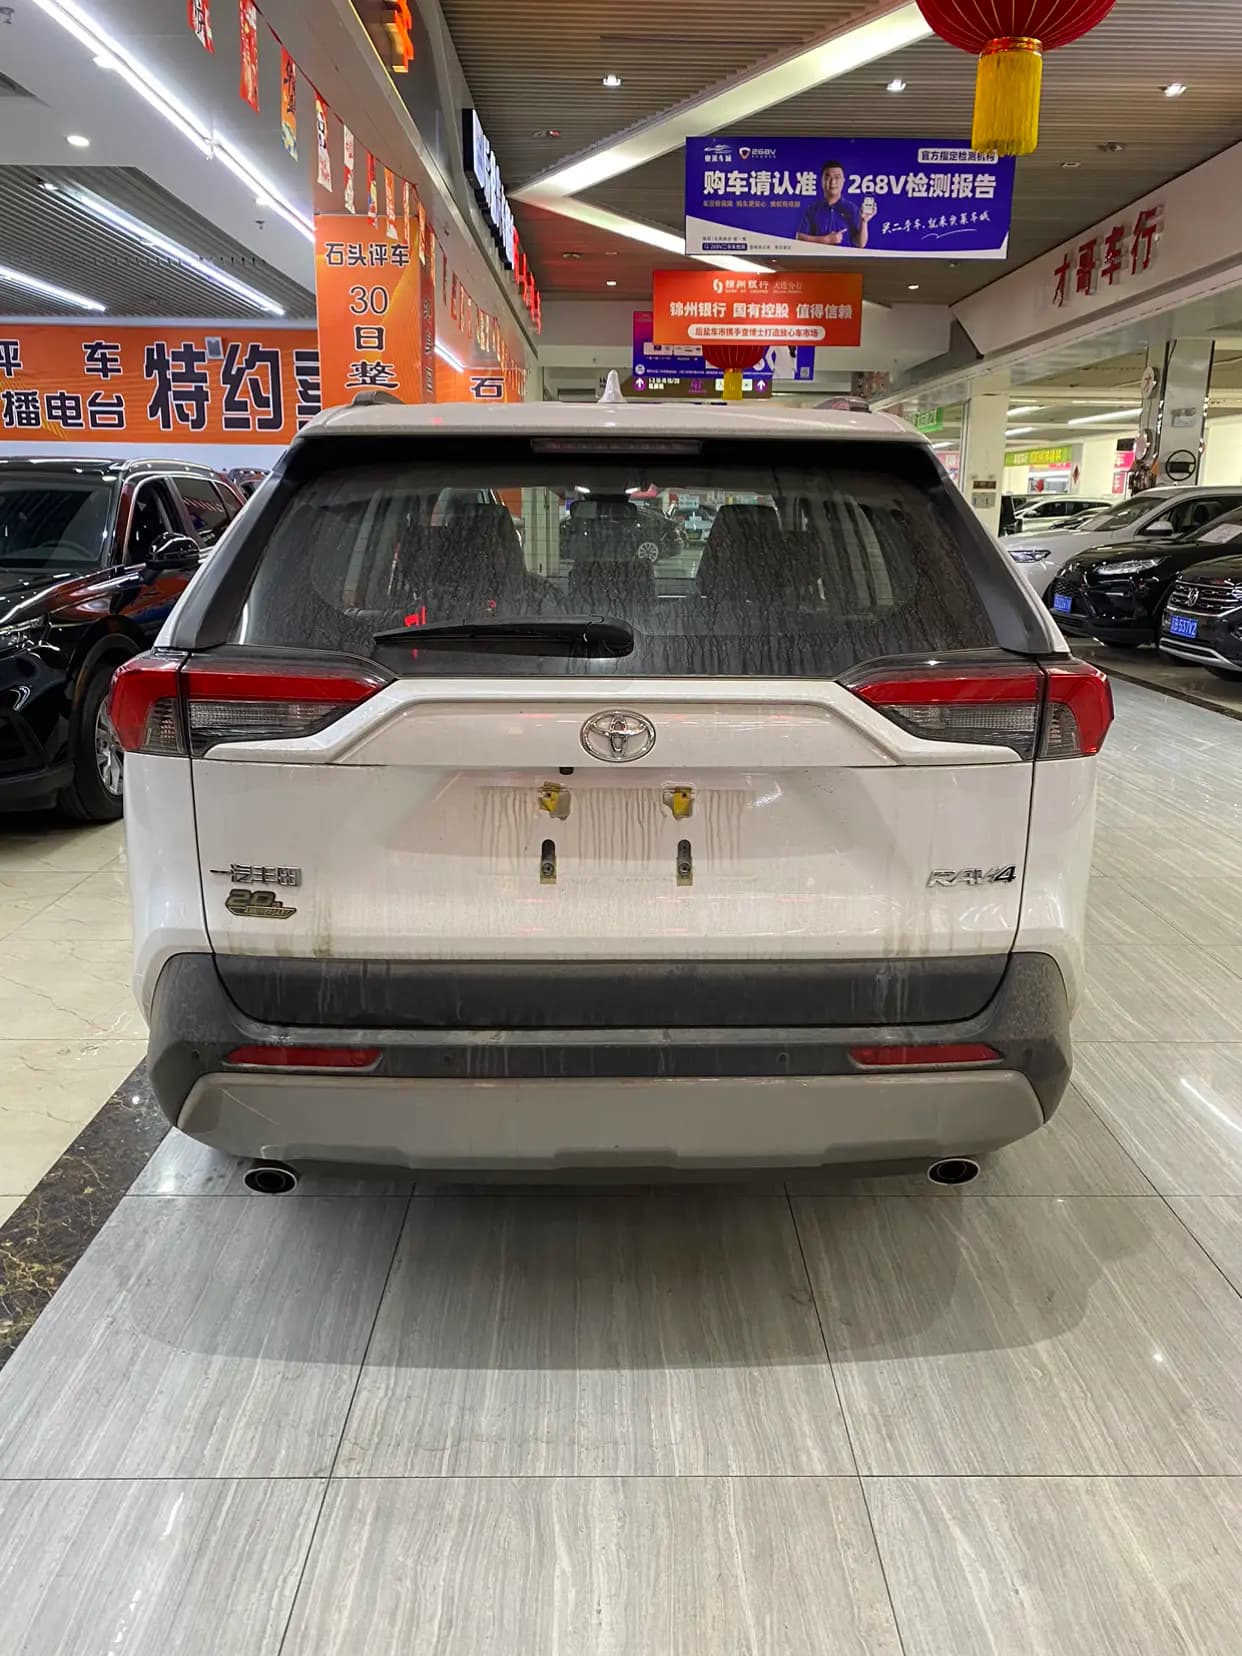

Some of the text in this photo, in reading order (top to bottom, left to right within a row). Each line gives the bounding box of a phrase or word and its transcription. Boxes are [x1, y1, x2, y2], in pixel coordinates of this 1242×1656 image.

[703, 170, 997, 199] 购车请认准 268V检测报告
[325, 242, 410, 267] 石头评车
[349, 285, 389, 315] 30
[670, 301, 853, 319] 锦州银行 国有控股 值得信赖
[354, 326, 385, 351] 日
[346, 361, 400, 390] 整
[1, 390, 126, 430] 播电台
